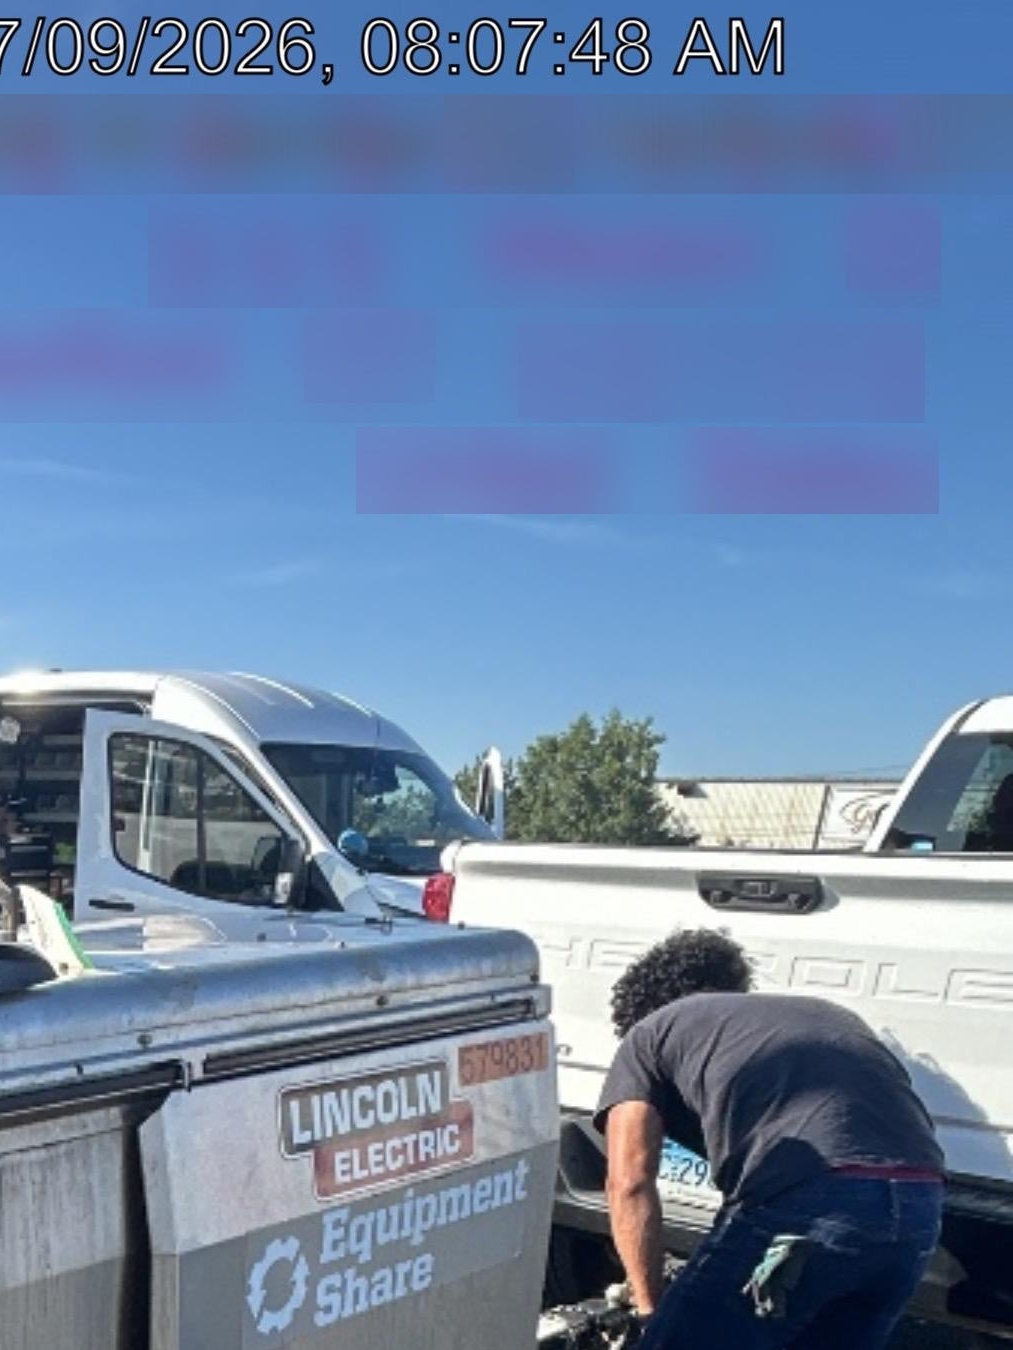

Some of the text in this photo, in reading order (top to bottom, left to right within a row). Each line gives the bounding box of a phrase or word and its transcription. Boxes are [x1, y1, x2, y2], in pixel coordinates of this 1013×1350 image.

[290, 1071, 442, 1145] LINCOLN
[334, 1124, 461, 1183] ELECTRIC
[319, 1158, 530, 1264] Equipment
[314, 1253, 435, 1328] Share
